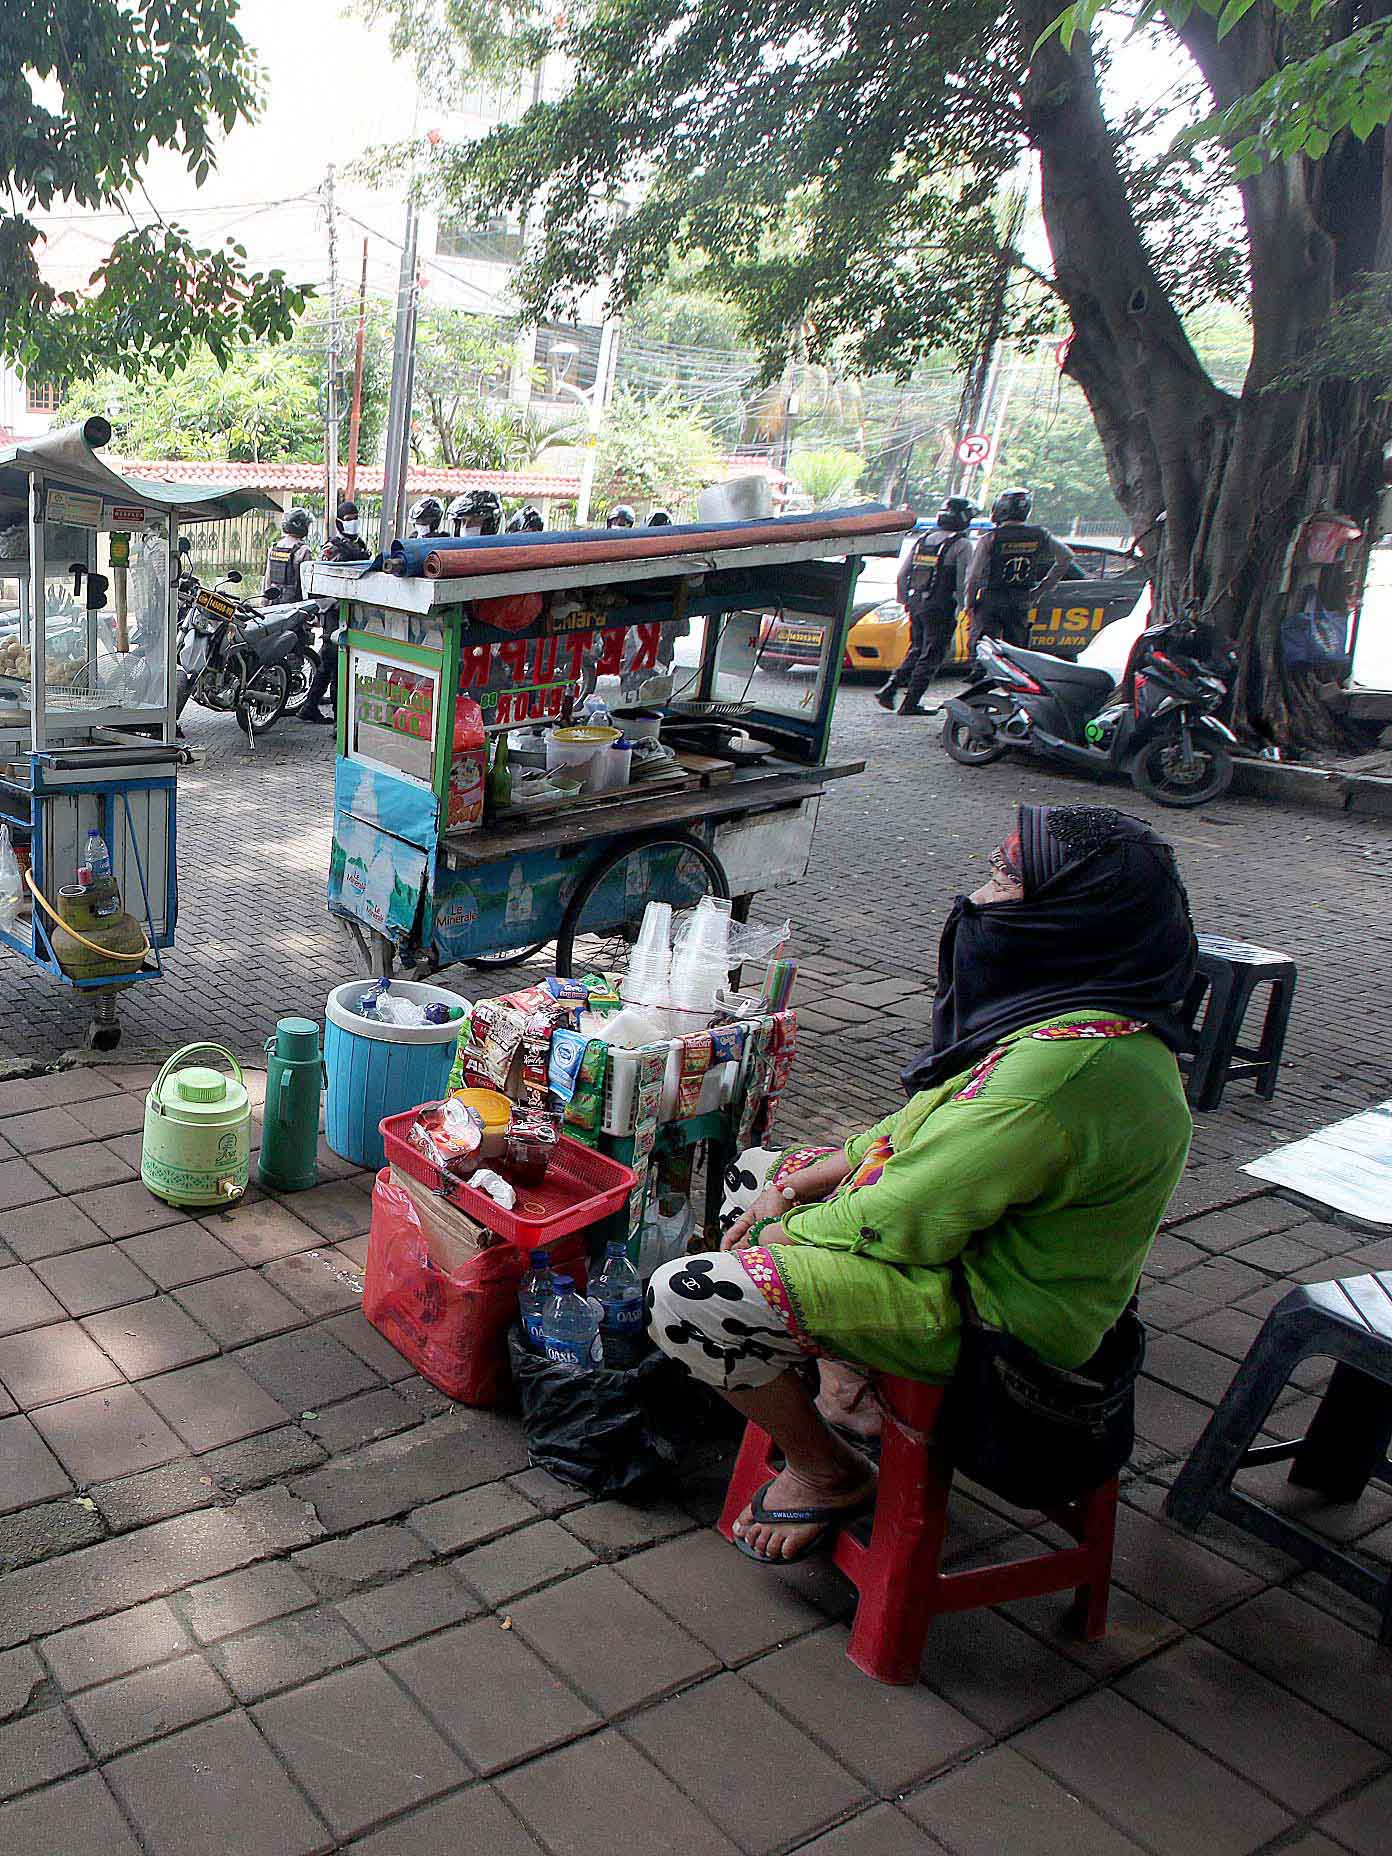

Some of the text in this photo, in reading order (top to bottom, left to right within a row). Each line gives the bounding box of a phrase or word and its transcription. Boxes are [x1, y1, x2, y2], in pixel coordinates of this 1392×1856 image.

[1029, 607, 1105, 631] LISI
[1032, 636, 1088, 646] TRO JAYA
[451, 903, 464, 915] Le
[436, 912, 477, 928] Minerale
[548, 1348, 578, 1363] OASIS
